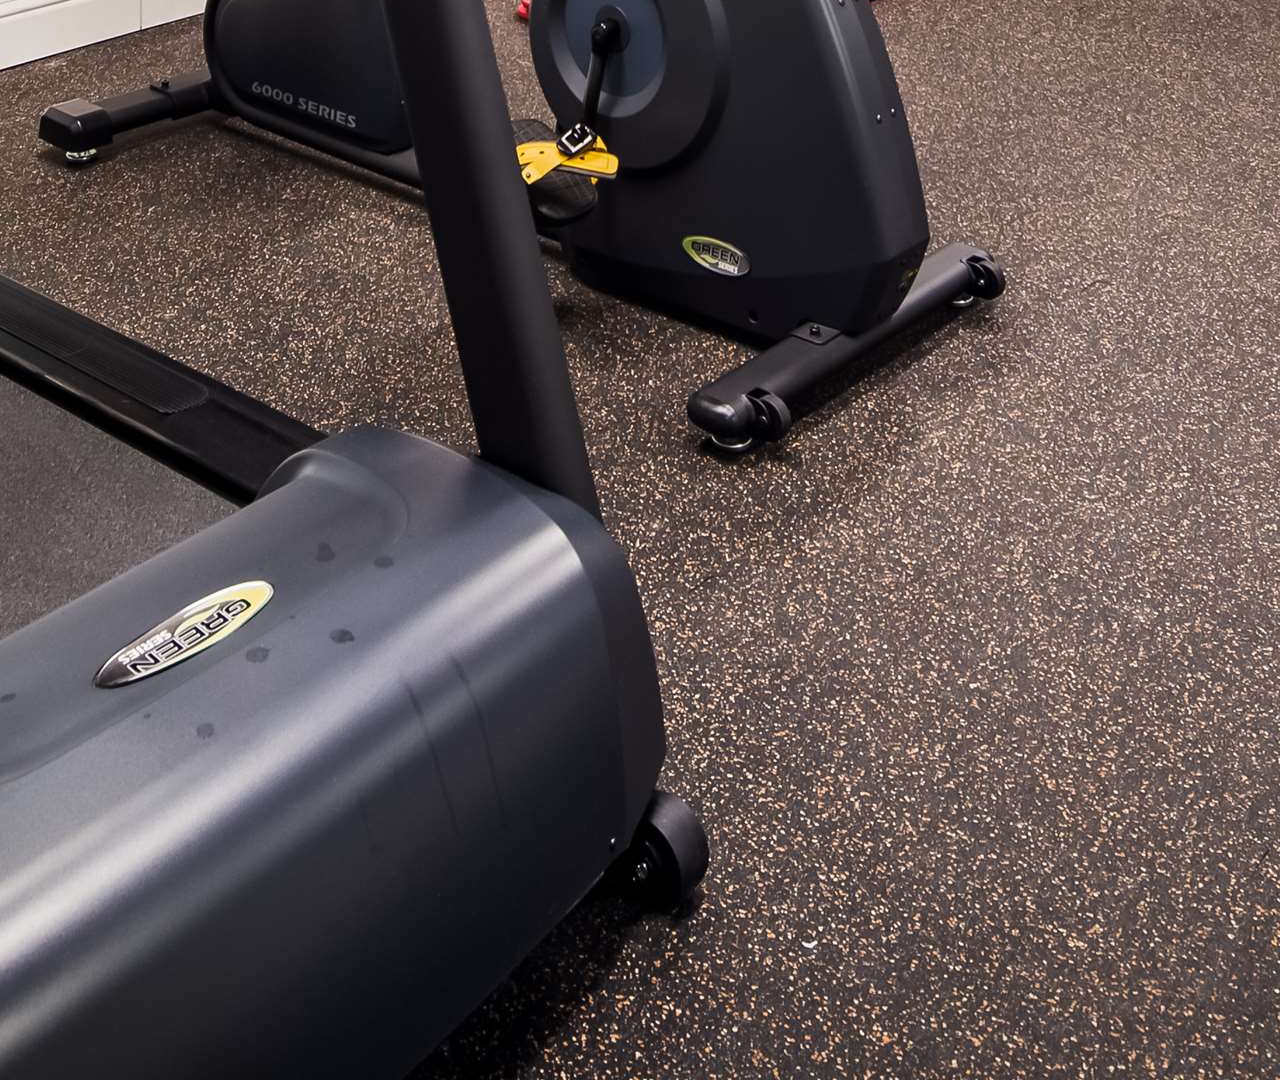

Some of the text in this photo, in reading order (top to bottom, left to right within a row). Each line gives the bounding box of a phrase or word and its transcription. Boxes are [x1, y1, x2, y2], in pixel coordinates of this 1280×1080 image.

[251, 80, 358, 129] 6000 SERIES
[691, 240, 740, 266] GREEN
[117, 629, 173, 665] SERIES
[126, 598, 252, 677] GREEN
